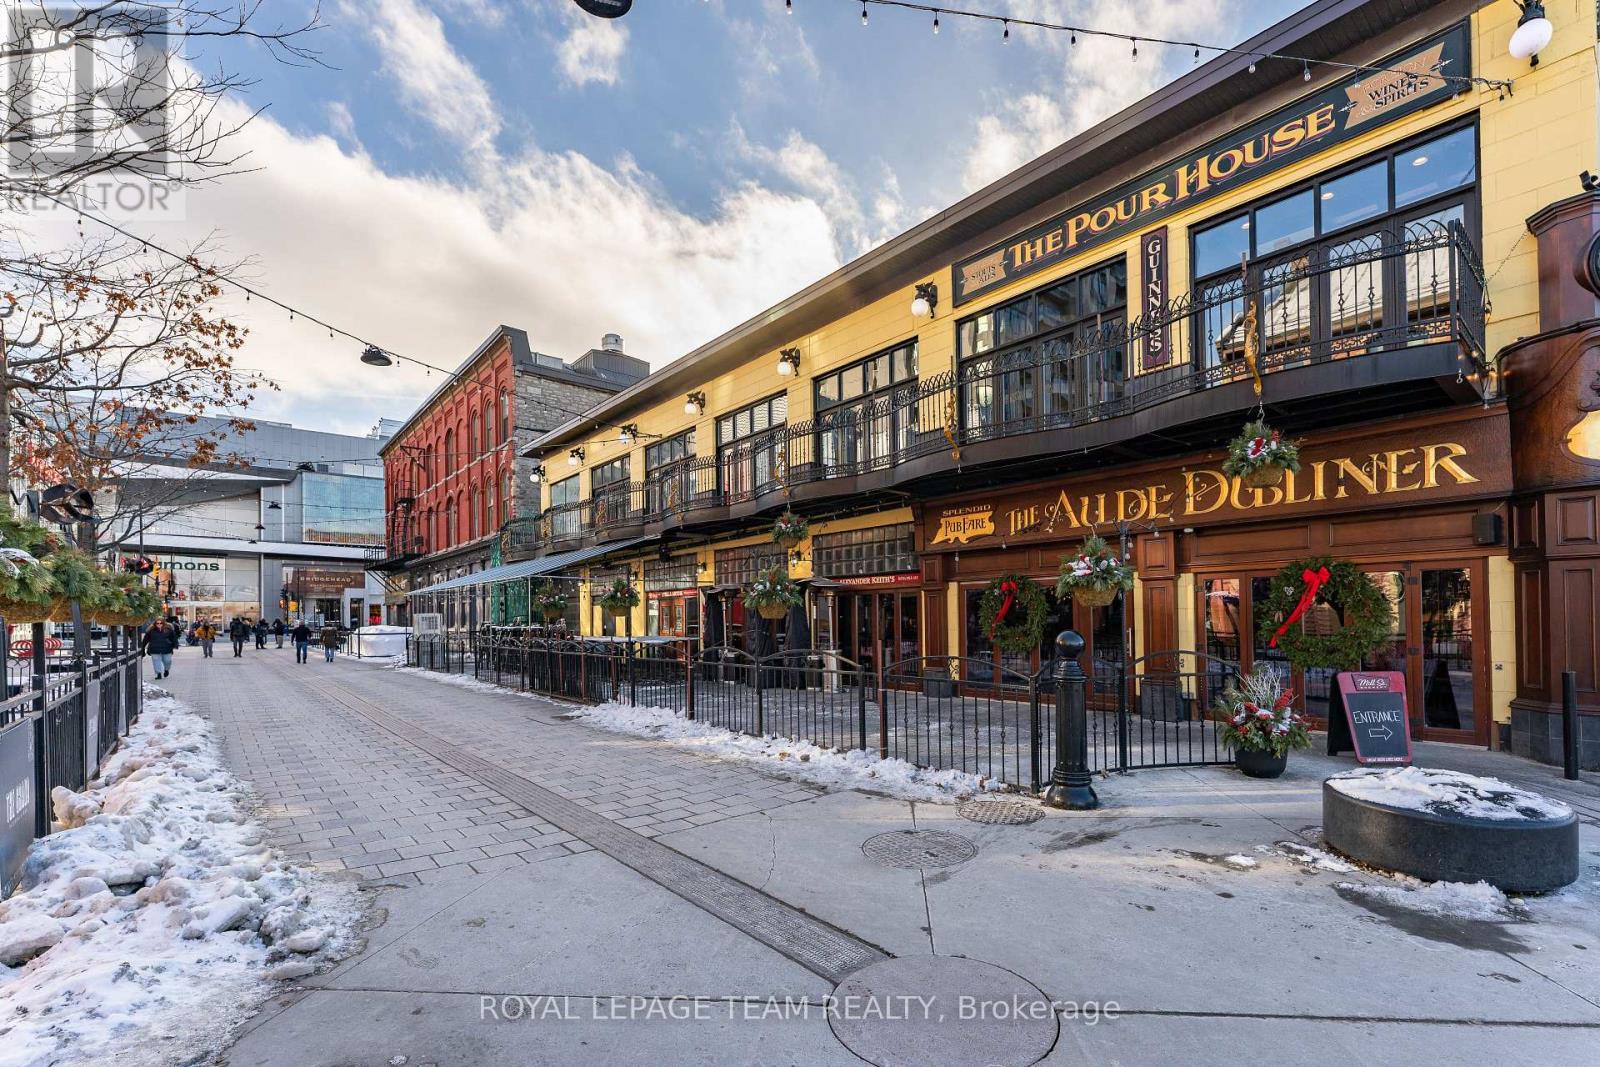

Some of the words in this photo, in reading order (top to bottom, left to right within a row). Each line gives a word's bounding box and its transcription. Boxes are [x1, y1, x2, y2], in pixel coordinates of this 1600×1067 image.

[1368, 71, 1418, 101] WINES
[1374, 78, 1430, 109] SPIRITS
[1008, 232, 1064, 269] THE
[1065, 182, 1173, 249] POUR
[1174, 103, 1337, 202] HOUSE
[1005, 504, 1042, 536] THE
[1044, 484, 1175, 532] AULDE
[1181, 442, 1481, 517] DUBLINER
[942, 504, 991, 517] SPLENDID
[1352, 709, 1401, 724] ENTRANCE
